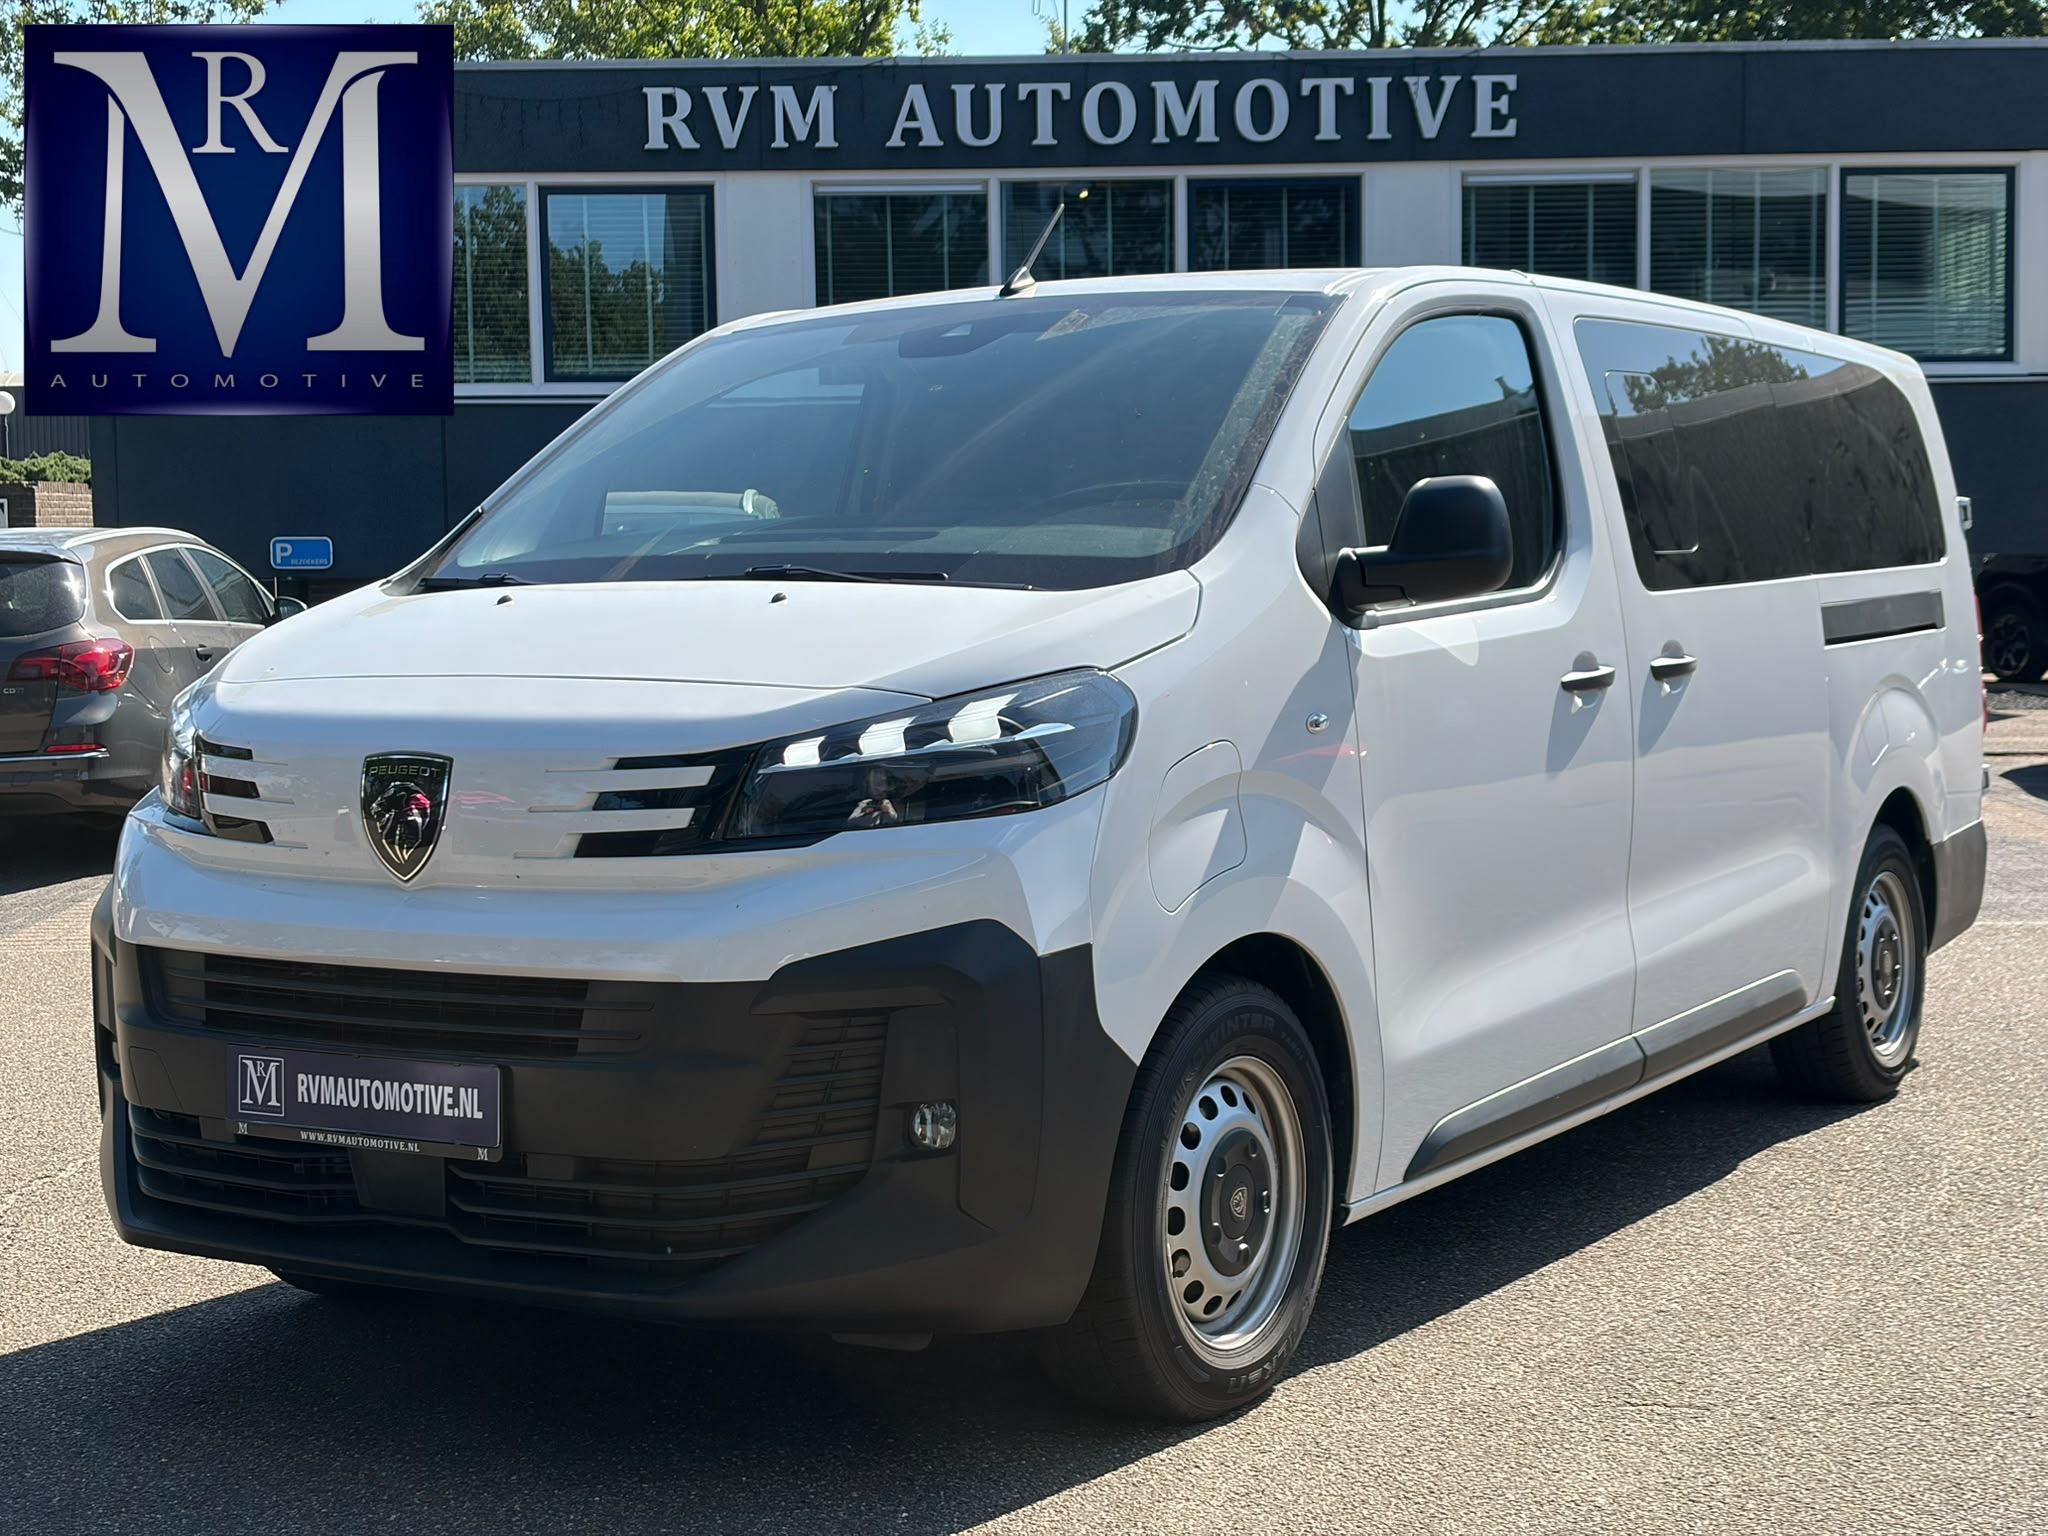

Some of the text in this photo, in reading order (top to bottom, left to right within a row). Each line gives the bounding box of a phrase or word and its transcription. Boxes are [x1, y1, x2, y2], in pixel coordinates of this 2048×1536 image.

[643, 73, 1519, 150] RVM AUTOMOTIVE
[275, 543, 293, 565] P
[368, 764, 441, 777] PEUGEOT
[297, 1072, 483, 1119] RVMAUTOMOTIVE.NL
[300, 1130, 420, 1153] WWW.RVMAUTOMOTIVE.NL
